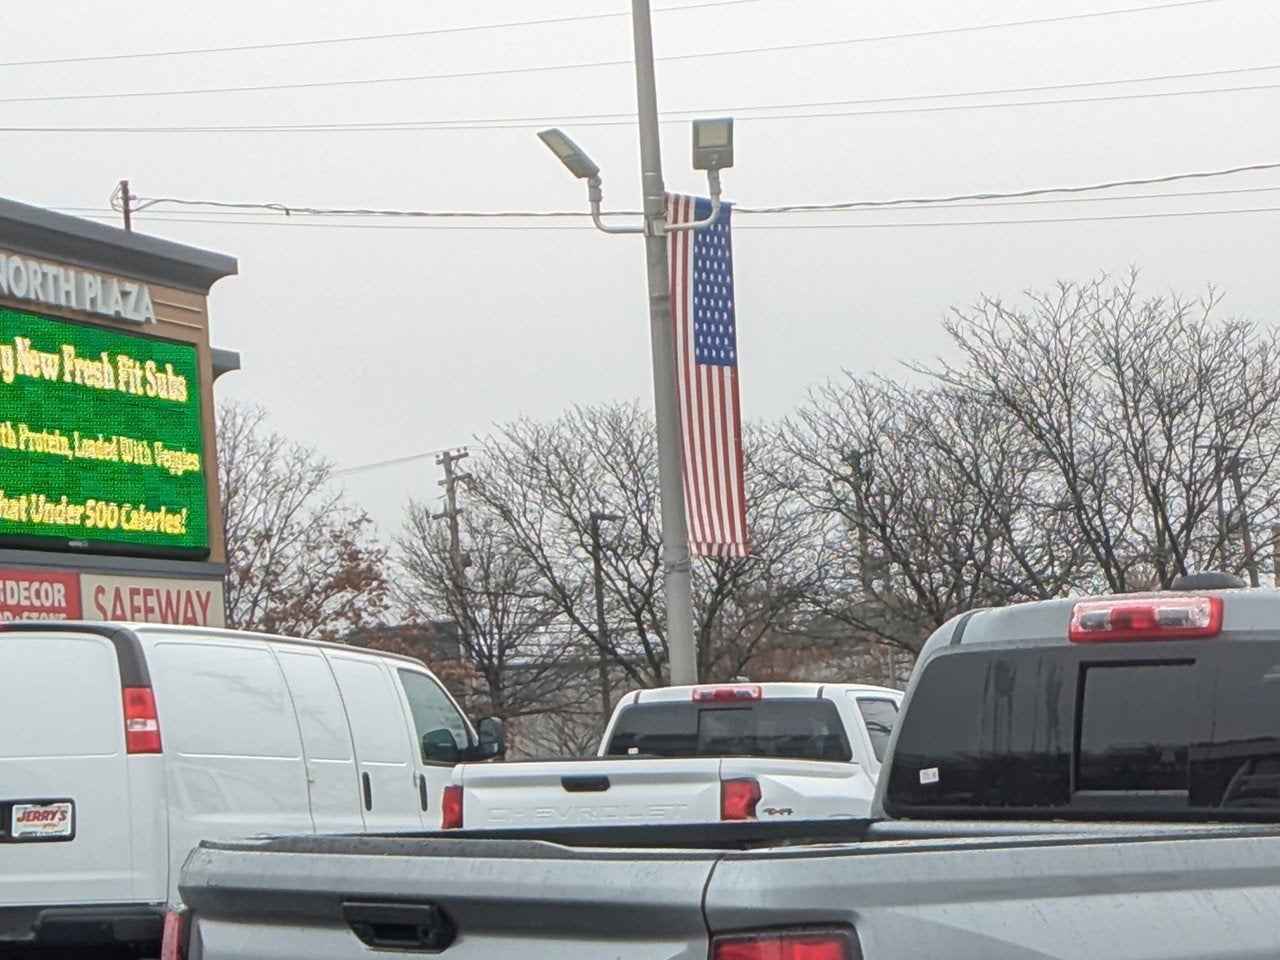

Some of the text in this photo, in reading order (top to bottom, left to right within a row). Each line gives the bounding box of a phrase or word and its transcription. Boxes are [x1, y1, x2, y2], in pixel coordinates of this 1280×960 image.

[82, 272, 157, 325] PLAZA
[14, 336, 60, 381] New
[61, 344, 115, 390] Fresh
[116, 354, 144, 396] Fit
[145, 360, 188, 402] Subs
[73, 431, 119, 462] Loaded
[119, 435, 153, 466] With
[153, 441, 200, 476] Veggies
[30, 493, 84, 526] Under
[85, 498, 119, 530] 500
[119, 503, 188, 535] Calories!
[93, 584, 211, 627] SAFEWAY
[17, 810, 68, 822] JERRY'S
